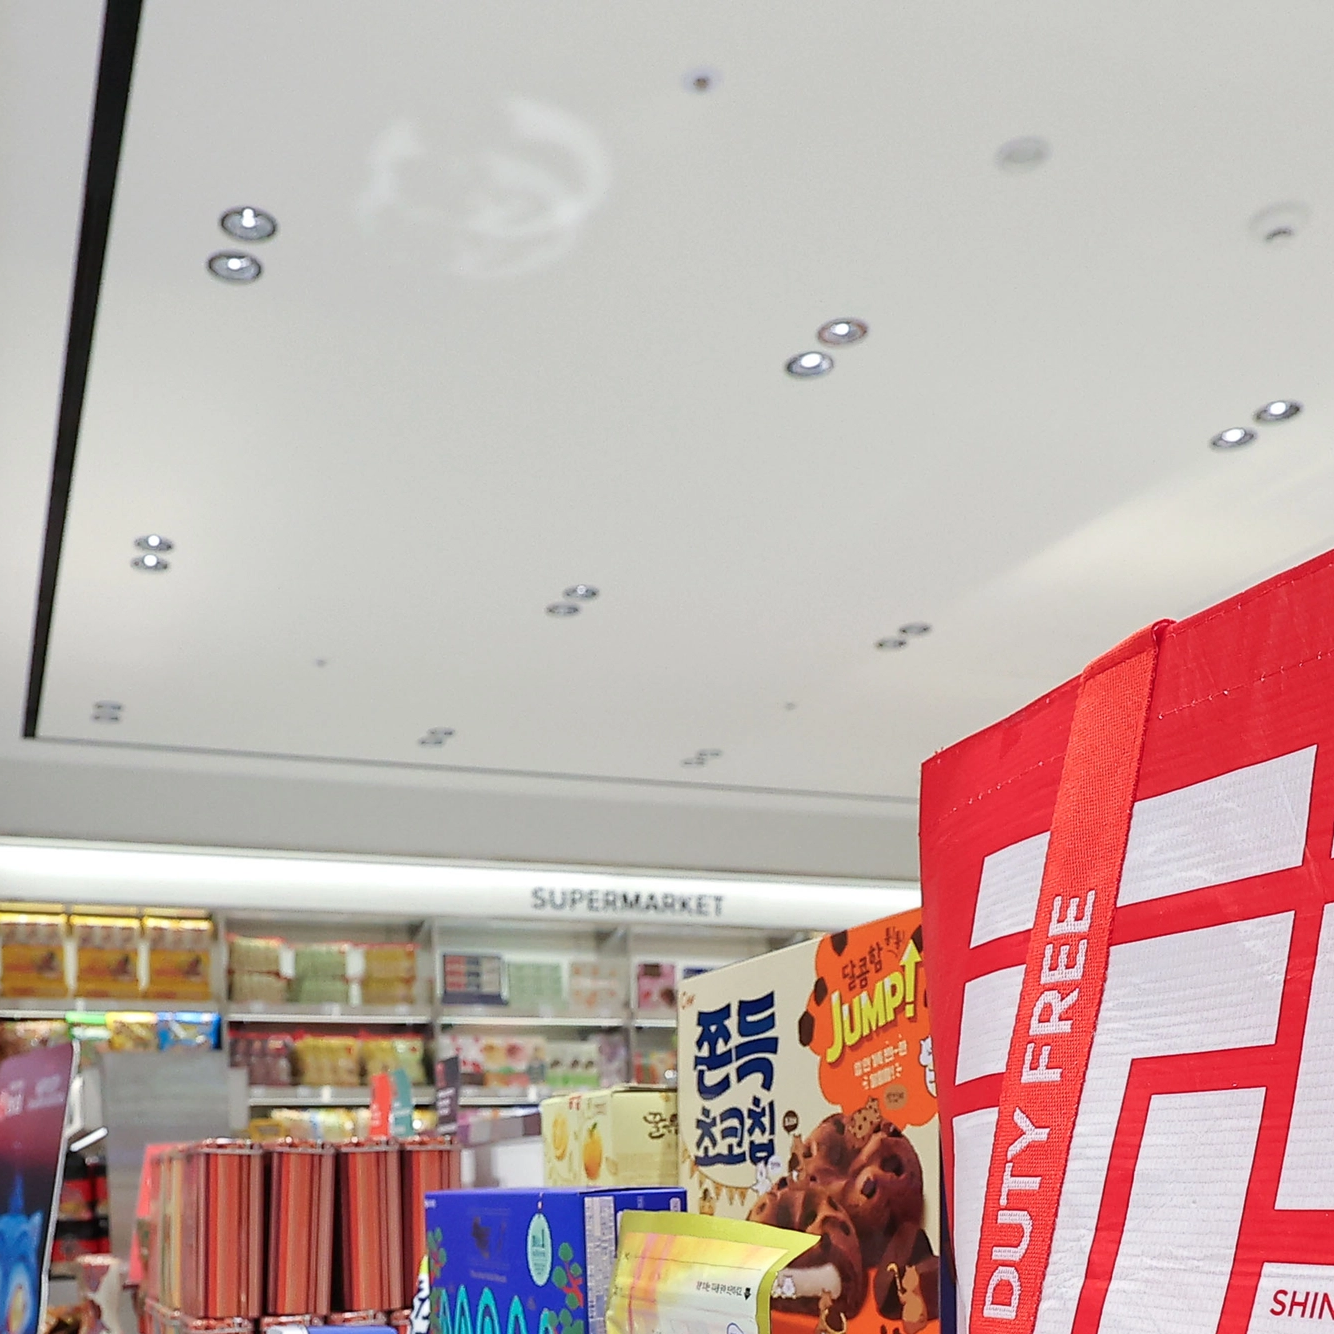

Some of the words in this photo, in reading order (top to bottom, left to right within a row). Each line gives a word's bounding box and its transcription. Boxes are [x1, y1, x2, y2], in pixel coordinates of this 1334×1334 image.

[531, 886, 725, 917] SUPERMARKET
[842, 942, 883, 992] 달콤함
[694, 990, 778, 1100] 쫀득
[694, 1095, 776, 1167] 초코칩
[982, 1106, 1050, 1320] DUTY
[1020, 889, 1095, 1084] FREE
